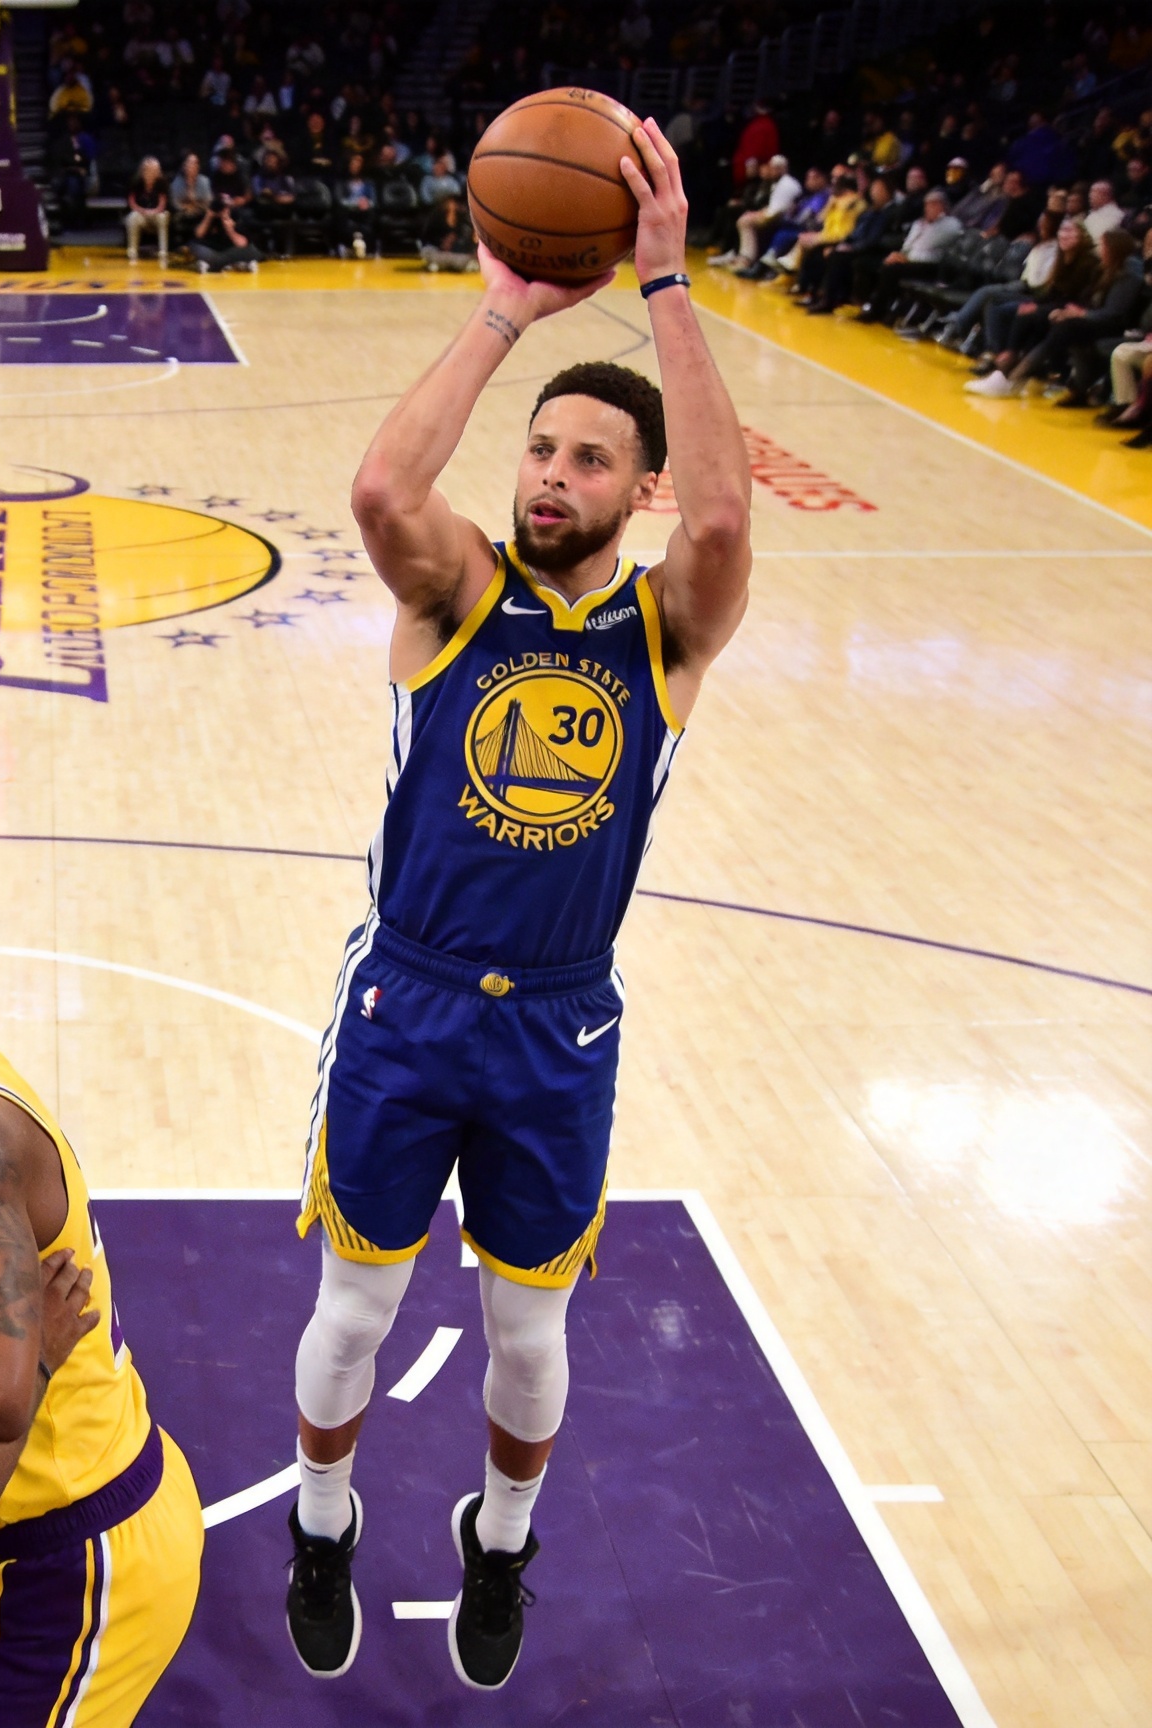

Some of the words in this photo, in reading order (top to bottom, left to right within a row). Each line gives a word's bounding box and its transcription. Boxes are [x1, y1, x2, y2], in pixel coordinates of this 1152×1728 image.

[476, 652, 570, 690] GOLDEN
[577, 658, 631, 708] STATE
[548, 705, 606, 748] 30
[458, 783, 616, 852] WARRIORS
